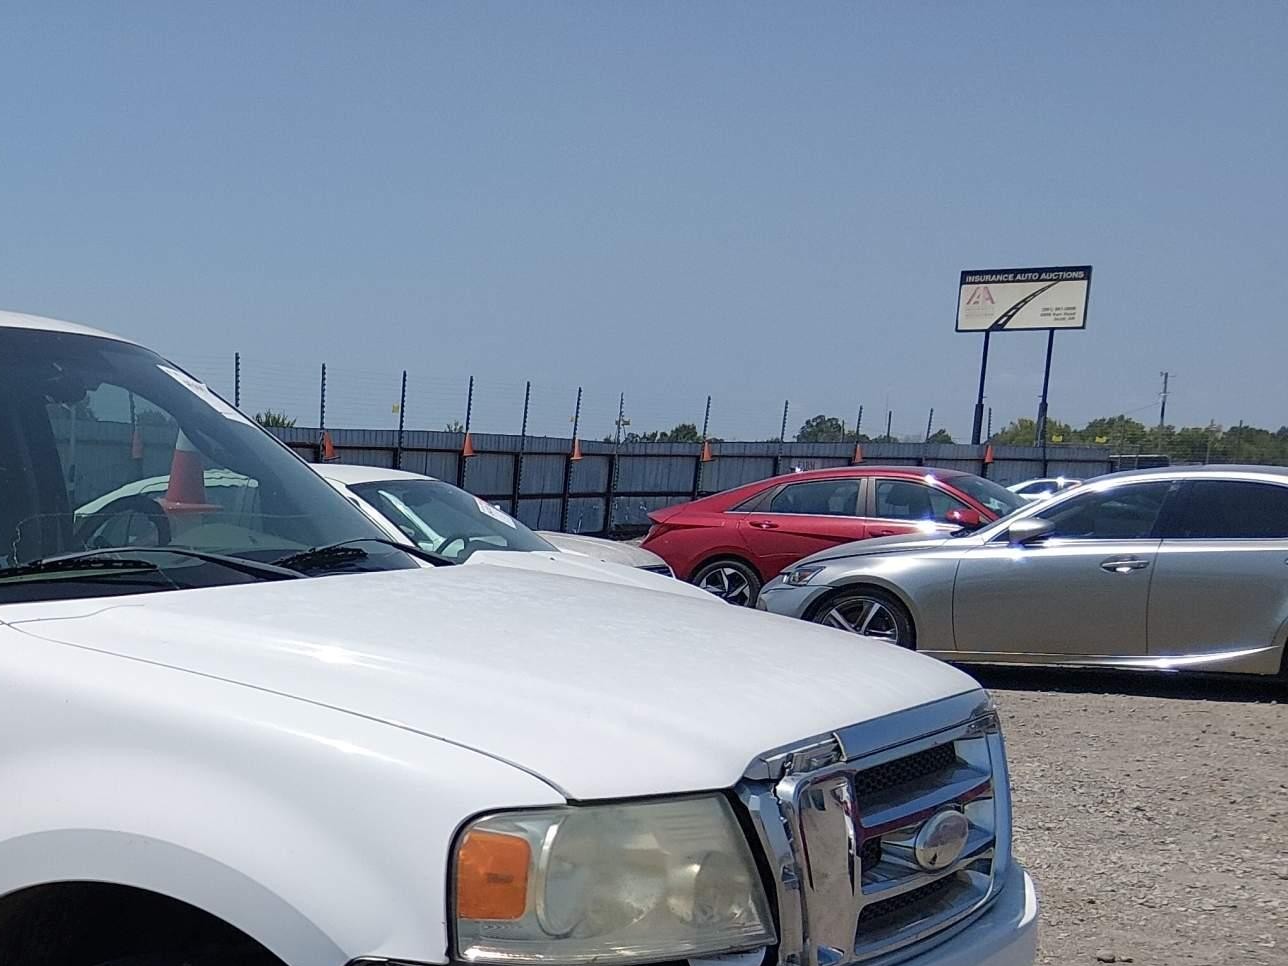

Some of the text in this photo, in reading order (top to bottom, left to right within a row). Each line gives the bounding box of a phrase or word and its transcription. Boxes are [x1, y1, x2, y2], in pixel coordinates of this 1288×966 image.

[966, 271, 1085, 283] INSURANCE AUTO AUCTIONS
